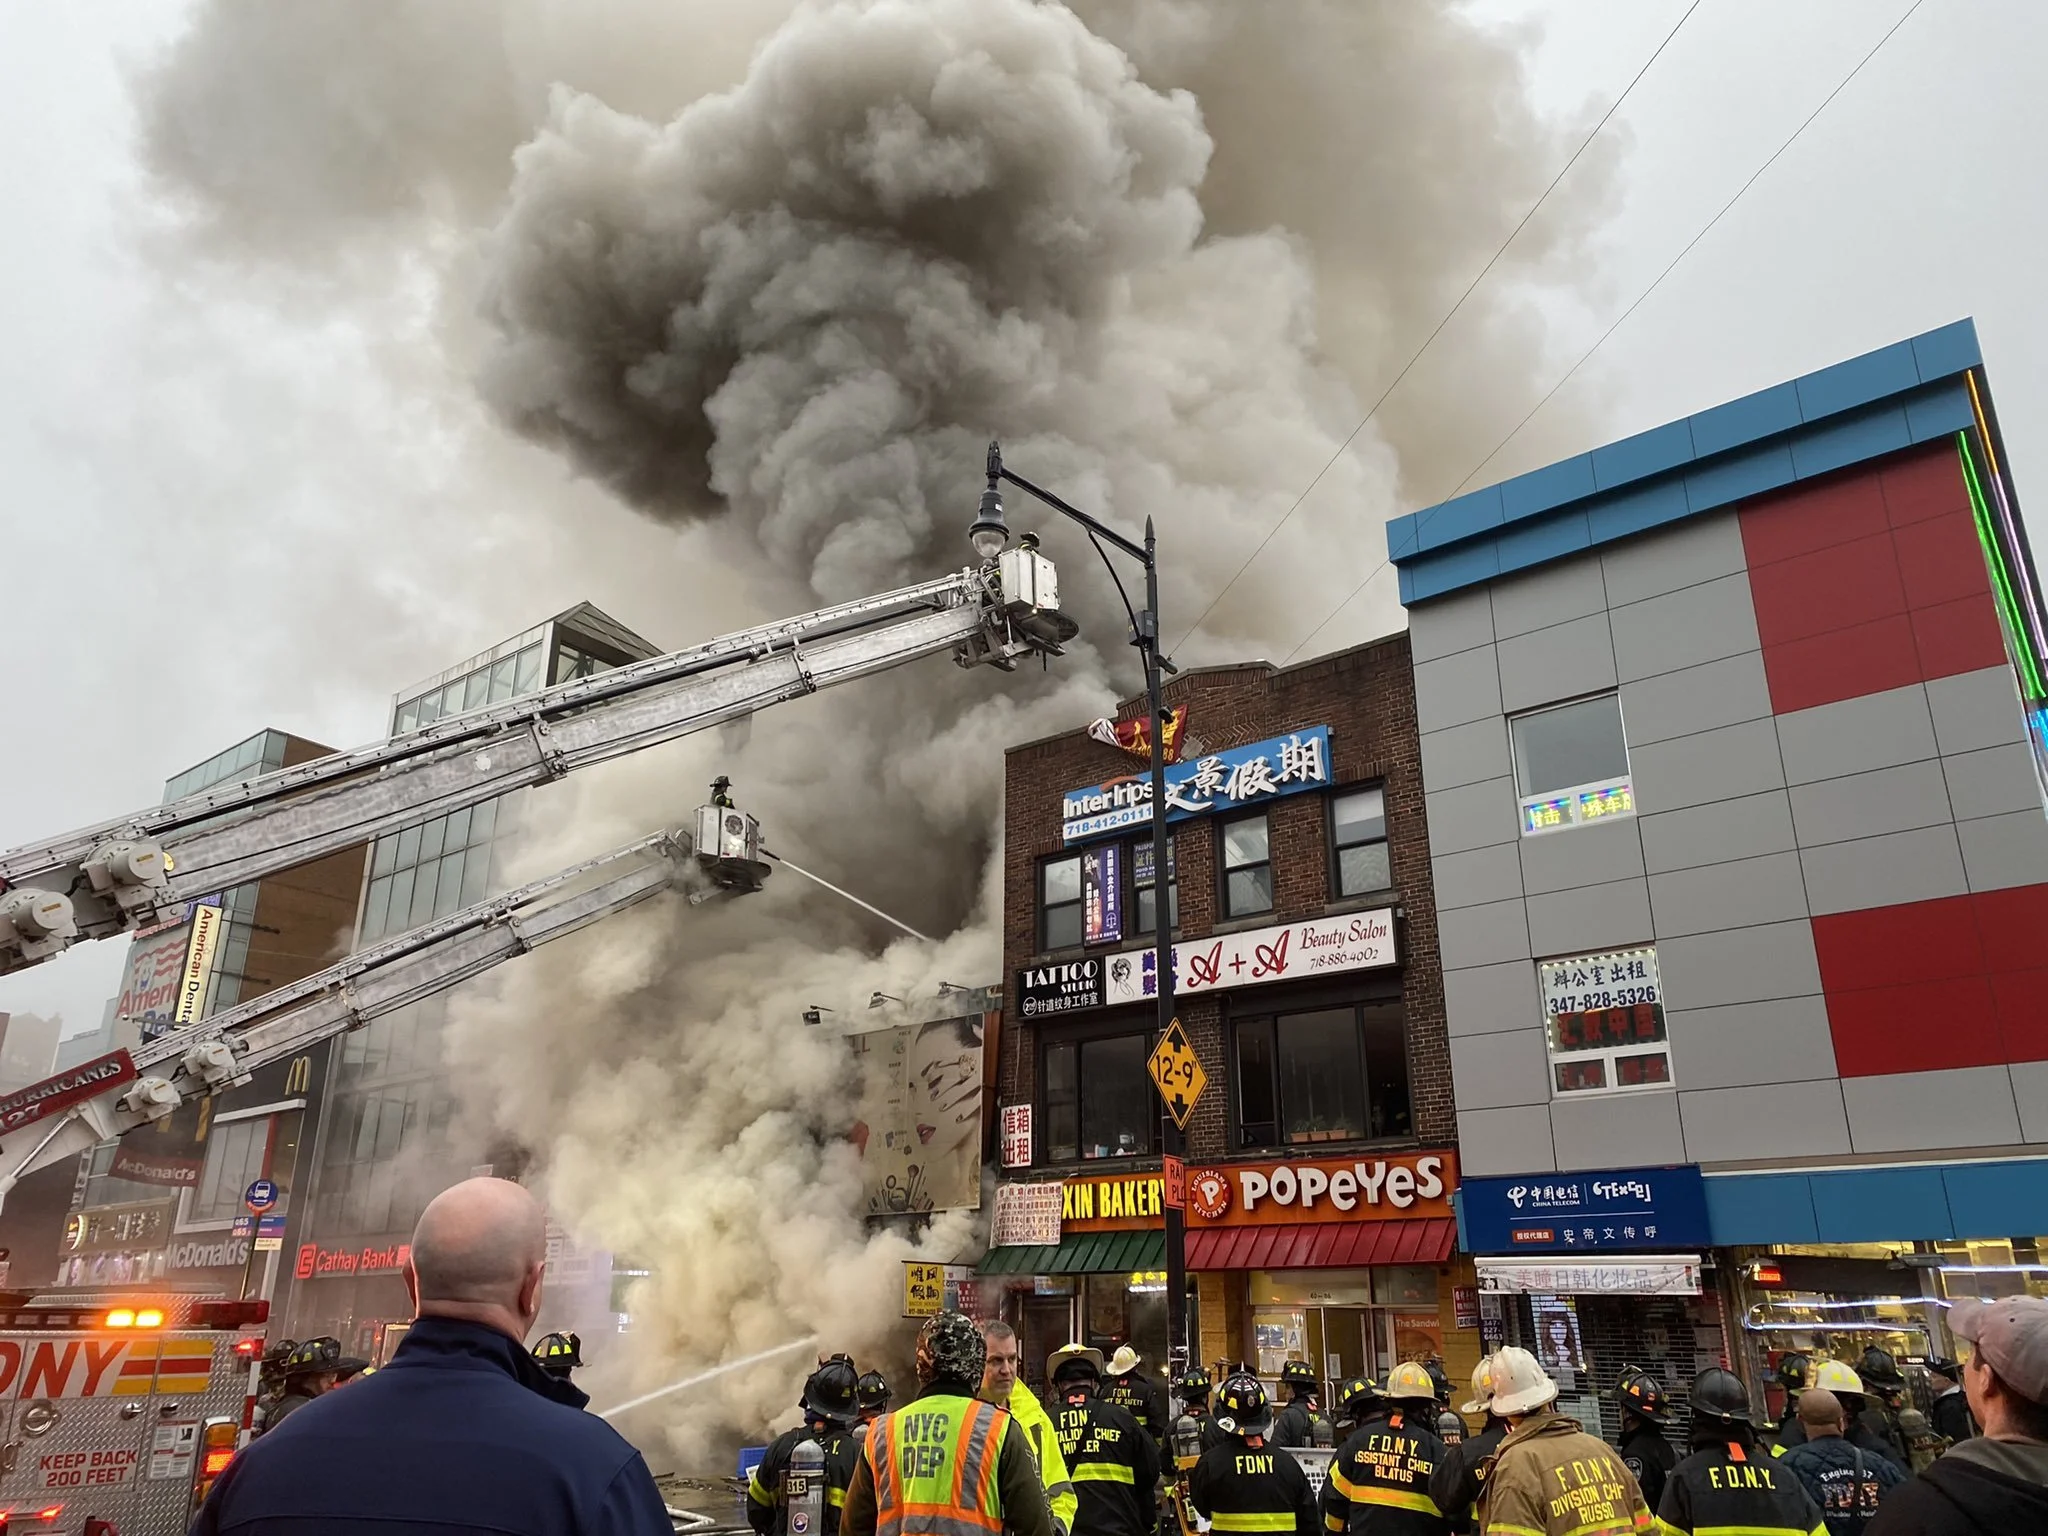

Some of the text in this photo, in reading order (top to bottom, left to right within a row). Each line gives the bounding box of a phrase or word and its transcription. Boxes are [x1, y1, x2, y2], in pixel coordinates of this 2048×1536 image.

[1067, 807, 1152, 836] 718-412-0111
[190, 909, 213, 978] American
[1300, 919, 1387, 950] Beauty Salon
[1187, 941, 1223, 988] A
[1252, 930, 1290, 977] A
[1310, 948, 1379, 970] 718-886-4902
[1023, 960, 1098, 989] TATTOO
[1061, 980, 1097, 994] STUDIO
[1550, 985, 1657, 1014] 347-828-5326
[1003, 1107, 1030, 1135] 信箱
[1003, 1138, 1030, 1165] 出租
[118, 1158, 196, 1180] McDonald's
[1192, 1170, 1227, 1191] LOUISIANA
[1531, 1184, 1579, 1201] 中国电信
[1533, 1199, 1580, 1208] CHINA TELECOM
[1193, 1200, 1227, 1218] KITCHEN
[167, 1238, 248, 1268] McDonald's
[316, 1249, 360, 1276] Cathay
[361, 1245, 396, 1269] Bank
[1396, 1320, 1409, 1328] The
[904, 1413, 949, 1443] NYC
[1060, 1409, 1091, 1429] FDN
[1094, 1428, 1121, 1442] CHIEF
[39, 1449, 138, 1470] KEEP BACK
[903, 1446, 945, 1478] DEP
[1235, 1455, 1273, 1474] FDNY
[46, 1467, 127, 1487] 200 FEET
[1375, 1465, 1413, 1483] BLATUS
[1820, 1468, 1855, 1482] Engine
[1550, 1485, 1600, 1518] DIVISION
[1578, 1501, 1615, 1524] RUSSO
